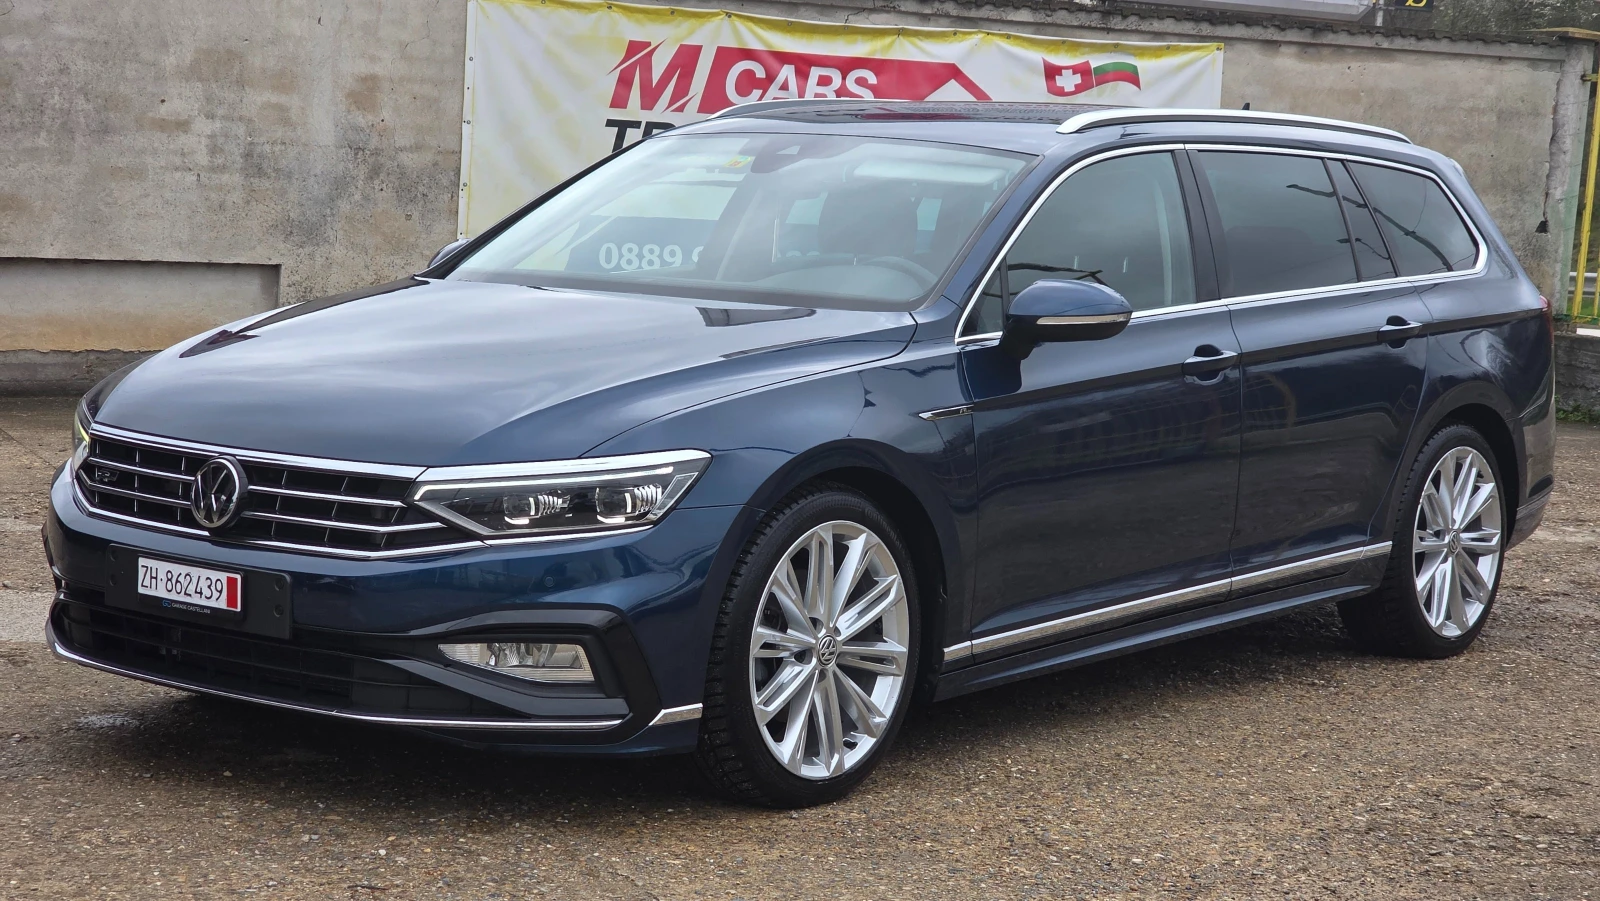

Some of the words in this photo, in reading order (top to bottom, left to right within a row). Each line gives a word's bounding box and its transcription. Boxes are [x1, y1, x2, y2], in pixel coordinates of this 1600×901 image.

[606, 38, 703, 114] M
[725, 60, 878, 105] CARS
[599, 242, 683, 271] 0889
